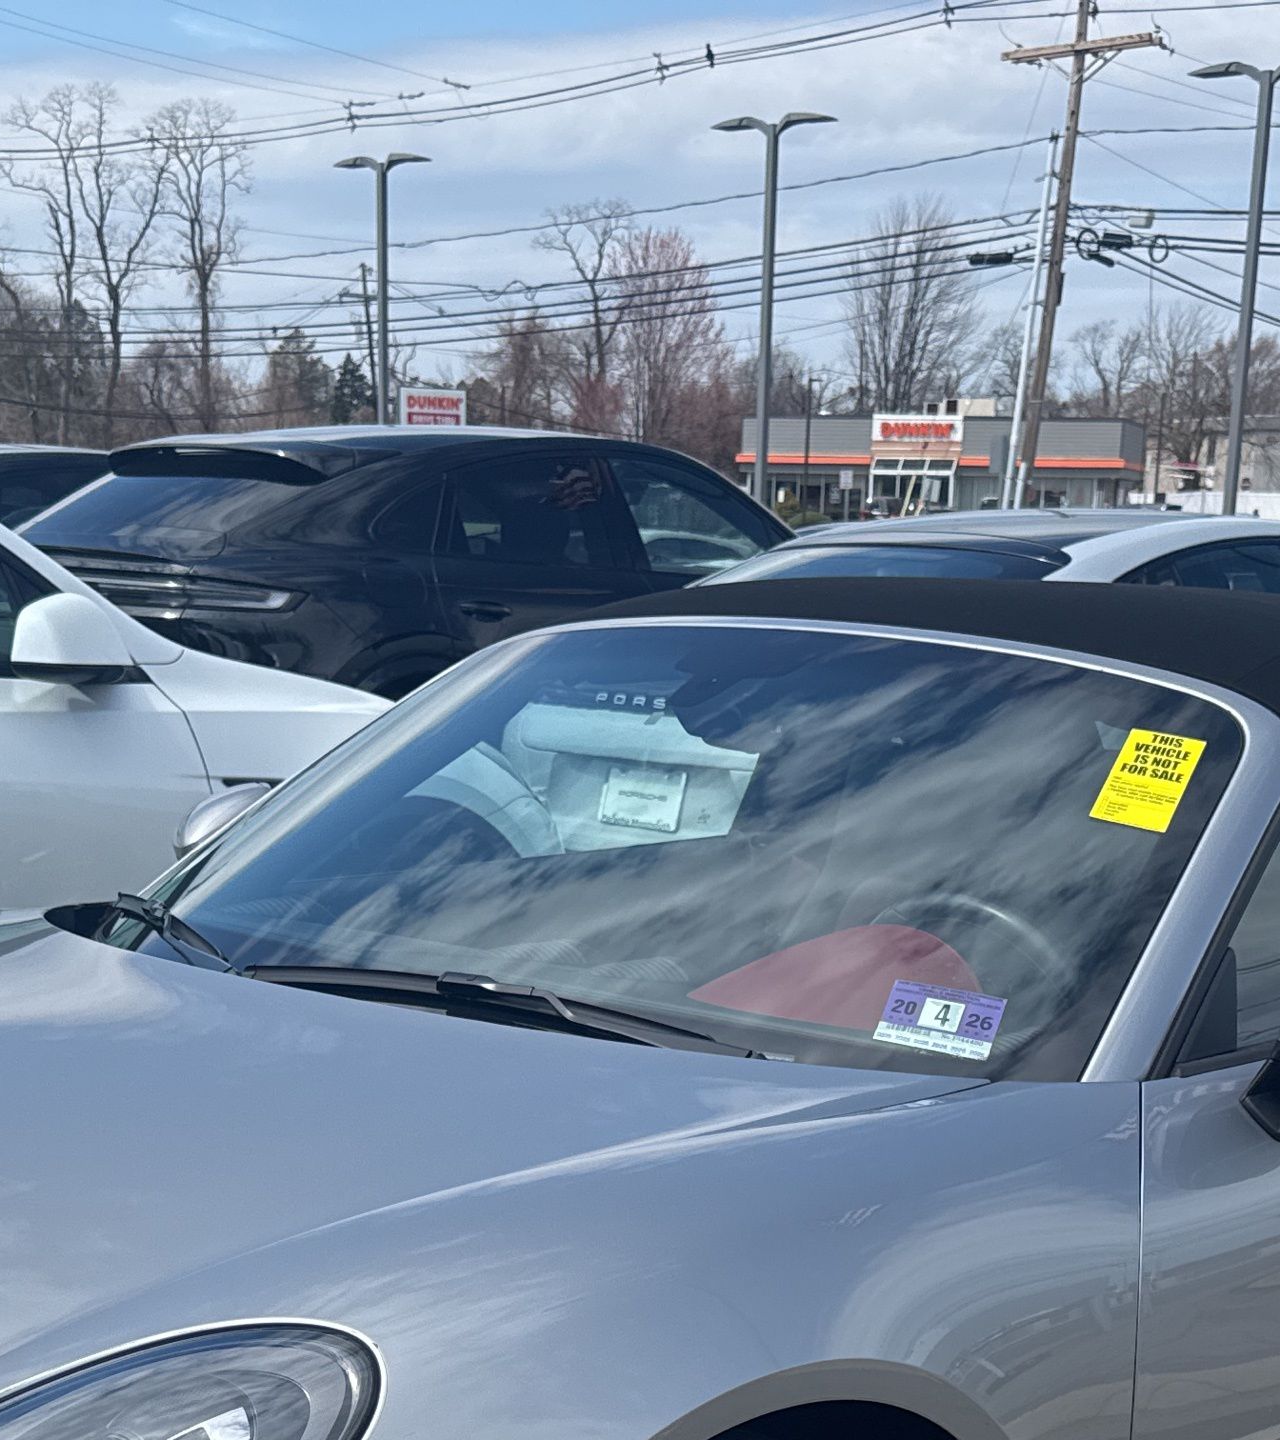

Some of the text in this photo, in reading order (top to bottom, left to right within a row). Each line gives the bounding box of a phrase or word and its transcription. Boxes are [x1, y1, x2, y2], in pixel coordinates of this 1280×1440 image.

[595, 692, 667, 710] PORS
[1151, 733, 1185, 748] THIS
[1134, 742, 1191, 761] VEHICLE
[1133, 754, 1182, 771] IS NOT
[1120, 762, 1185, 784] FOR SALE
[890, 998, 995, 1031] 20 4 26
